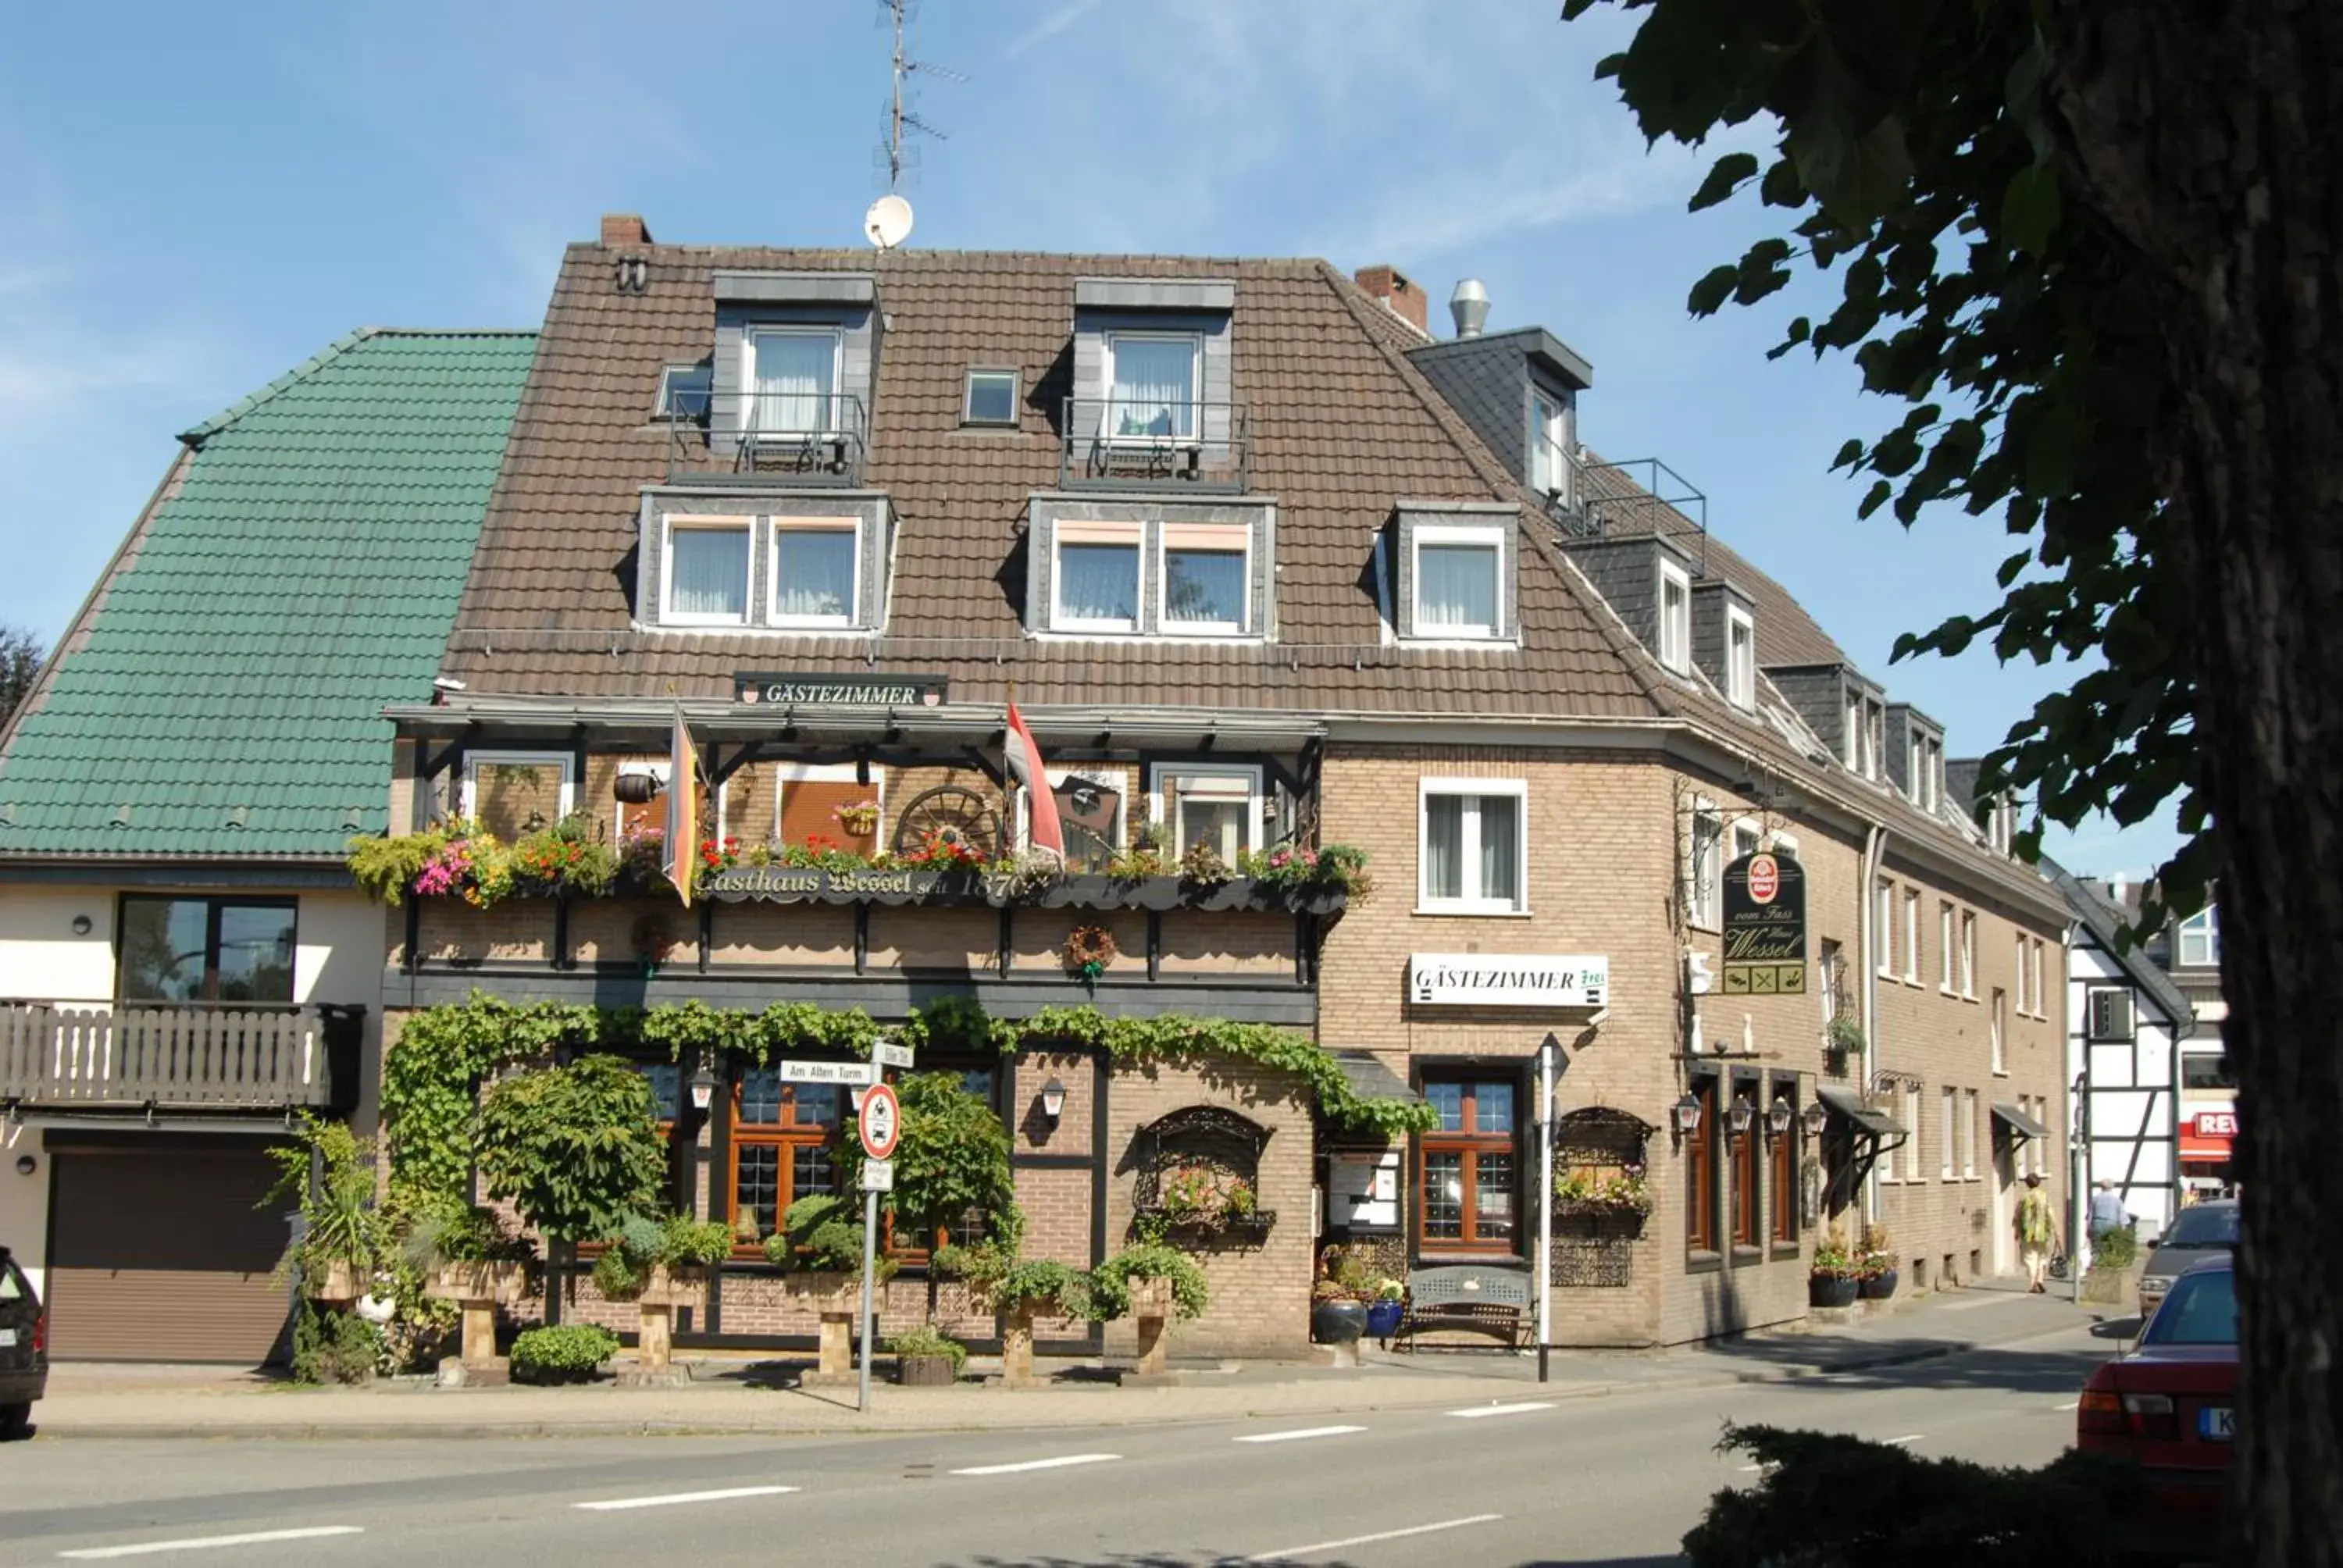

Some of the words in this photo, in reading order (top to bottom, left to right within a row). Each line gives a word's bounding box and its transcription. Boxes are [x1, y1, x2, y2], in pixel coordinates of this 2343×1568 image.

[766, 684, 915, 704] GÄSTEZIMMER
[829, 872, 911, 896] Wessel
[1724, 927, 1803, 958] Wessel
[1415, 964, 1574, 989] GÄSTEZIMMER
[790, 1065, 805, 1077] Am
[811, 1065, 833, 1078] Alten
[839, 1067, 862, 1078] Turm
[2200, 1115, 2238, 1133] RE
